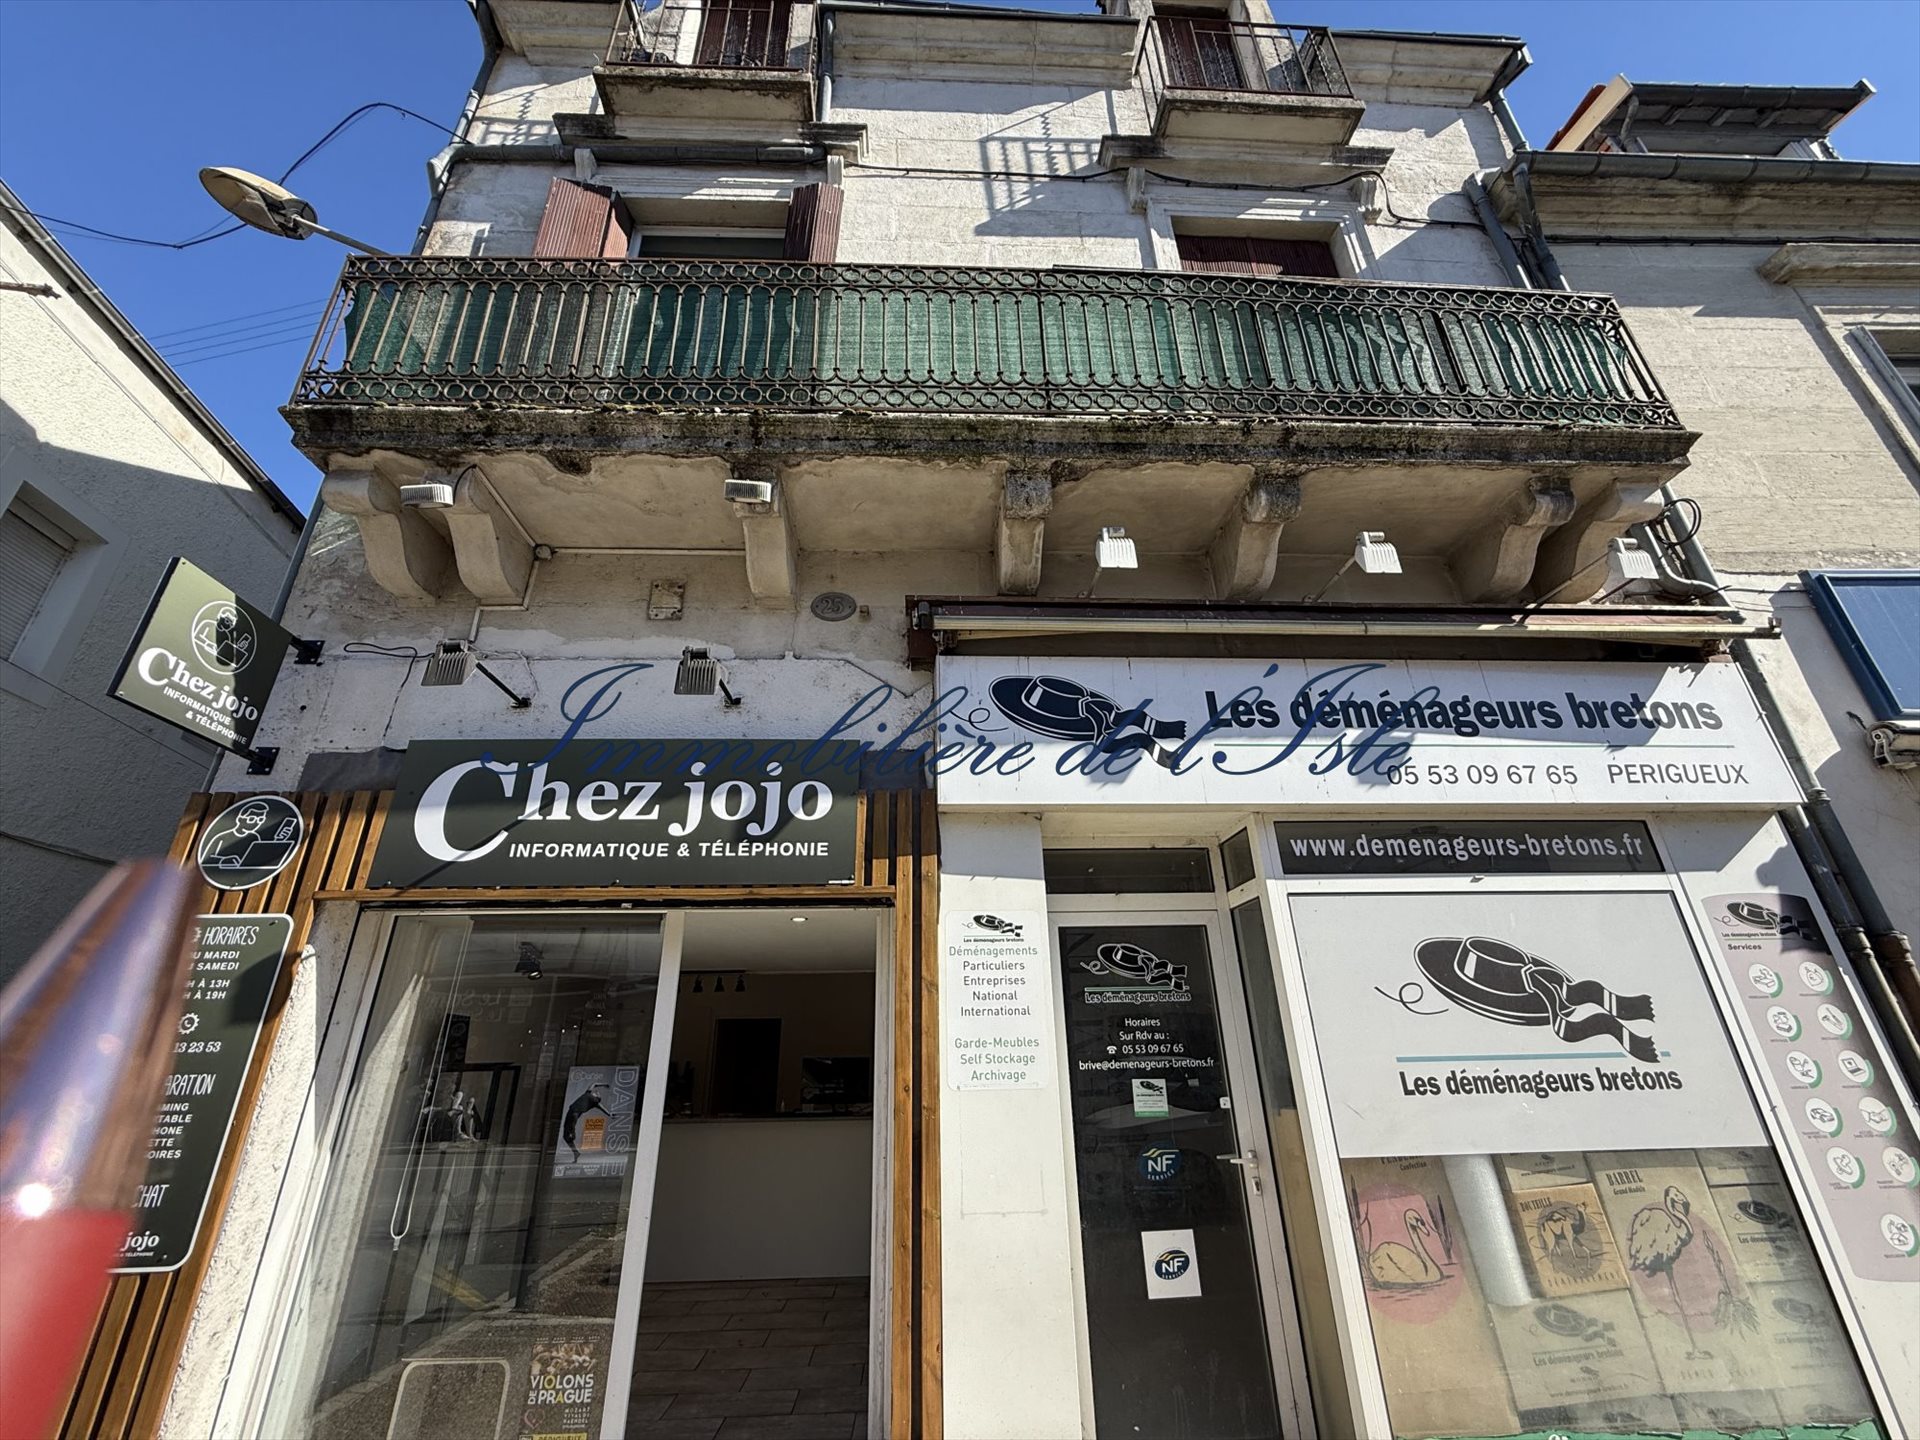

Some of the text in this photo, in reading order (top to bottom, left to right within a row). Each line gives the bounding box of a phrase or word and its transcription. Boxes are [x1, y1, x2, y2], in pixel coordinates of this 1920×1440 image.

[138, 647, 258, 721] Chez jojo
[163, 686, 232, 725] INFORMATIQUE
[1205, 690, 1723, 738] Les déménageurs bretons
[185, 710, 248, 745] & TÉLÉPHONIE
[1387, 763, 1750, 785] 05 53 09 67 65 PERIGUEUX
[414, 760, 833, 862] Chez jojo
[509, 838, 829, 859] INFORMATIQUE & TÉLÉPHONIE
[1290, 833, 1644, 861] www.demenageurs-bretons.fr
[202, 926, 260, 946] HORAIRES
[949, 945, 1038, 958] Déménagements
[1727, 943, 1762, 951] Services
[203, 951, 240, 959] MARDI
[196, 962, 240, 971] SAMEDI
[963, 960, 1026, 971] Particuliers
[209, 980, 230, 988] 13H
[963, 975, 1026, 988] Entreprises
[205, 991, 227, 1000] 19H
[972, 990, 1018, 1001] National
[1085, 992, 1101, 1003] Les
[1158, 991, 1191, 1002] bretons
[960, 1006, 1031, 1017] International
[1124, 1018, 1161, 1027] Horaires
[1119, 1031, 1134, 1040] Sur
[1135, 1031, 1152, 1040] Rdv
[1153, 1032, 1165, 1040] au
[188, 1041, 204, 1052] 23
[205, 1041, 222, 1052] 53
[954, 1037, 1040, 1049] Garde-Meubles
[1122, 1044, 1184, 1054] 05 53 09 67 65
[960, 1052, 1036, 1066] Self Stockage
[1079, 1057, 1215, 1071] brive@demenageurs-bretons.fr
[971, 1069, 1027, 1083] Archivage
[1399, 1066, 1683, 1099] Les déménageurs bretons
[165, 1073, 217, 1096] ARATION
[159, 1103, 189, 1111] MING
[157, 1114, 193, 1123] TABLE
[601, 1066, 639, 1177] DANSE
[146, 1149, 182, 1159] OIRES
[1147, 1154, 1176, 1173] NF
[120, 1230, 160, 1251] jojo
[1161, 1257, 1185, 1274] NF
[530, 1374, 594, 1390] VIOLONS
[528, 1388, 593, 1405] DE PRAGUE
